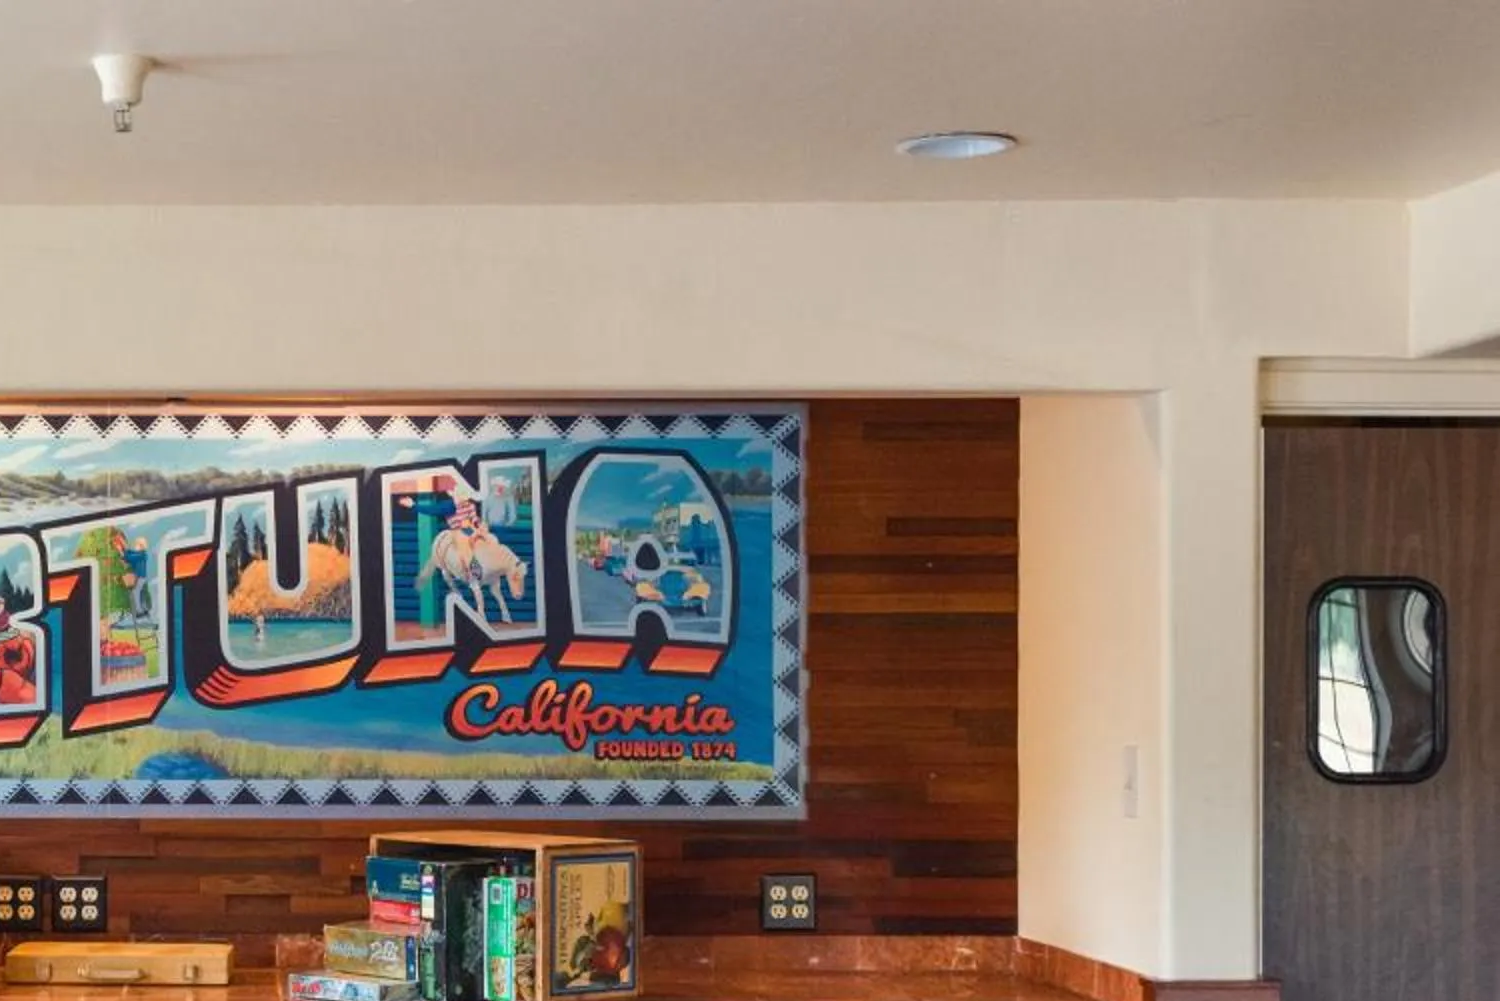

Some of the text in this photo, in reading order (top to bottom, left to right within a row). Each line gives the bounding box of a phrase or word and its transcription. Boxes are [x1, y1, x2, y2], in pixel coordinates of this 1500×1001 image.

[443, 679, 736, 750] California
[595, 739, 737, 761] FOUNDED 1874
